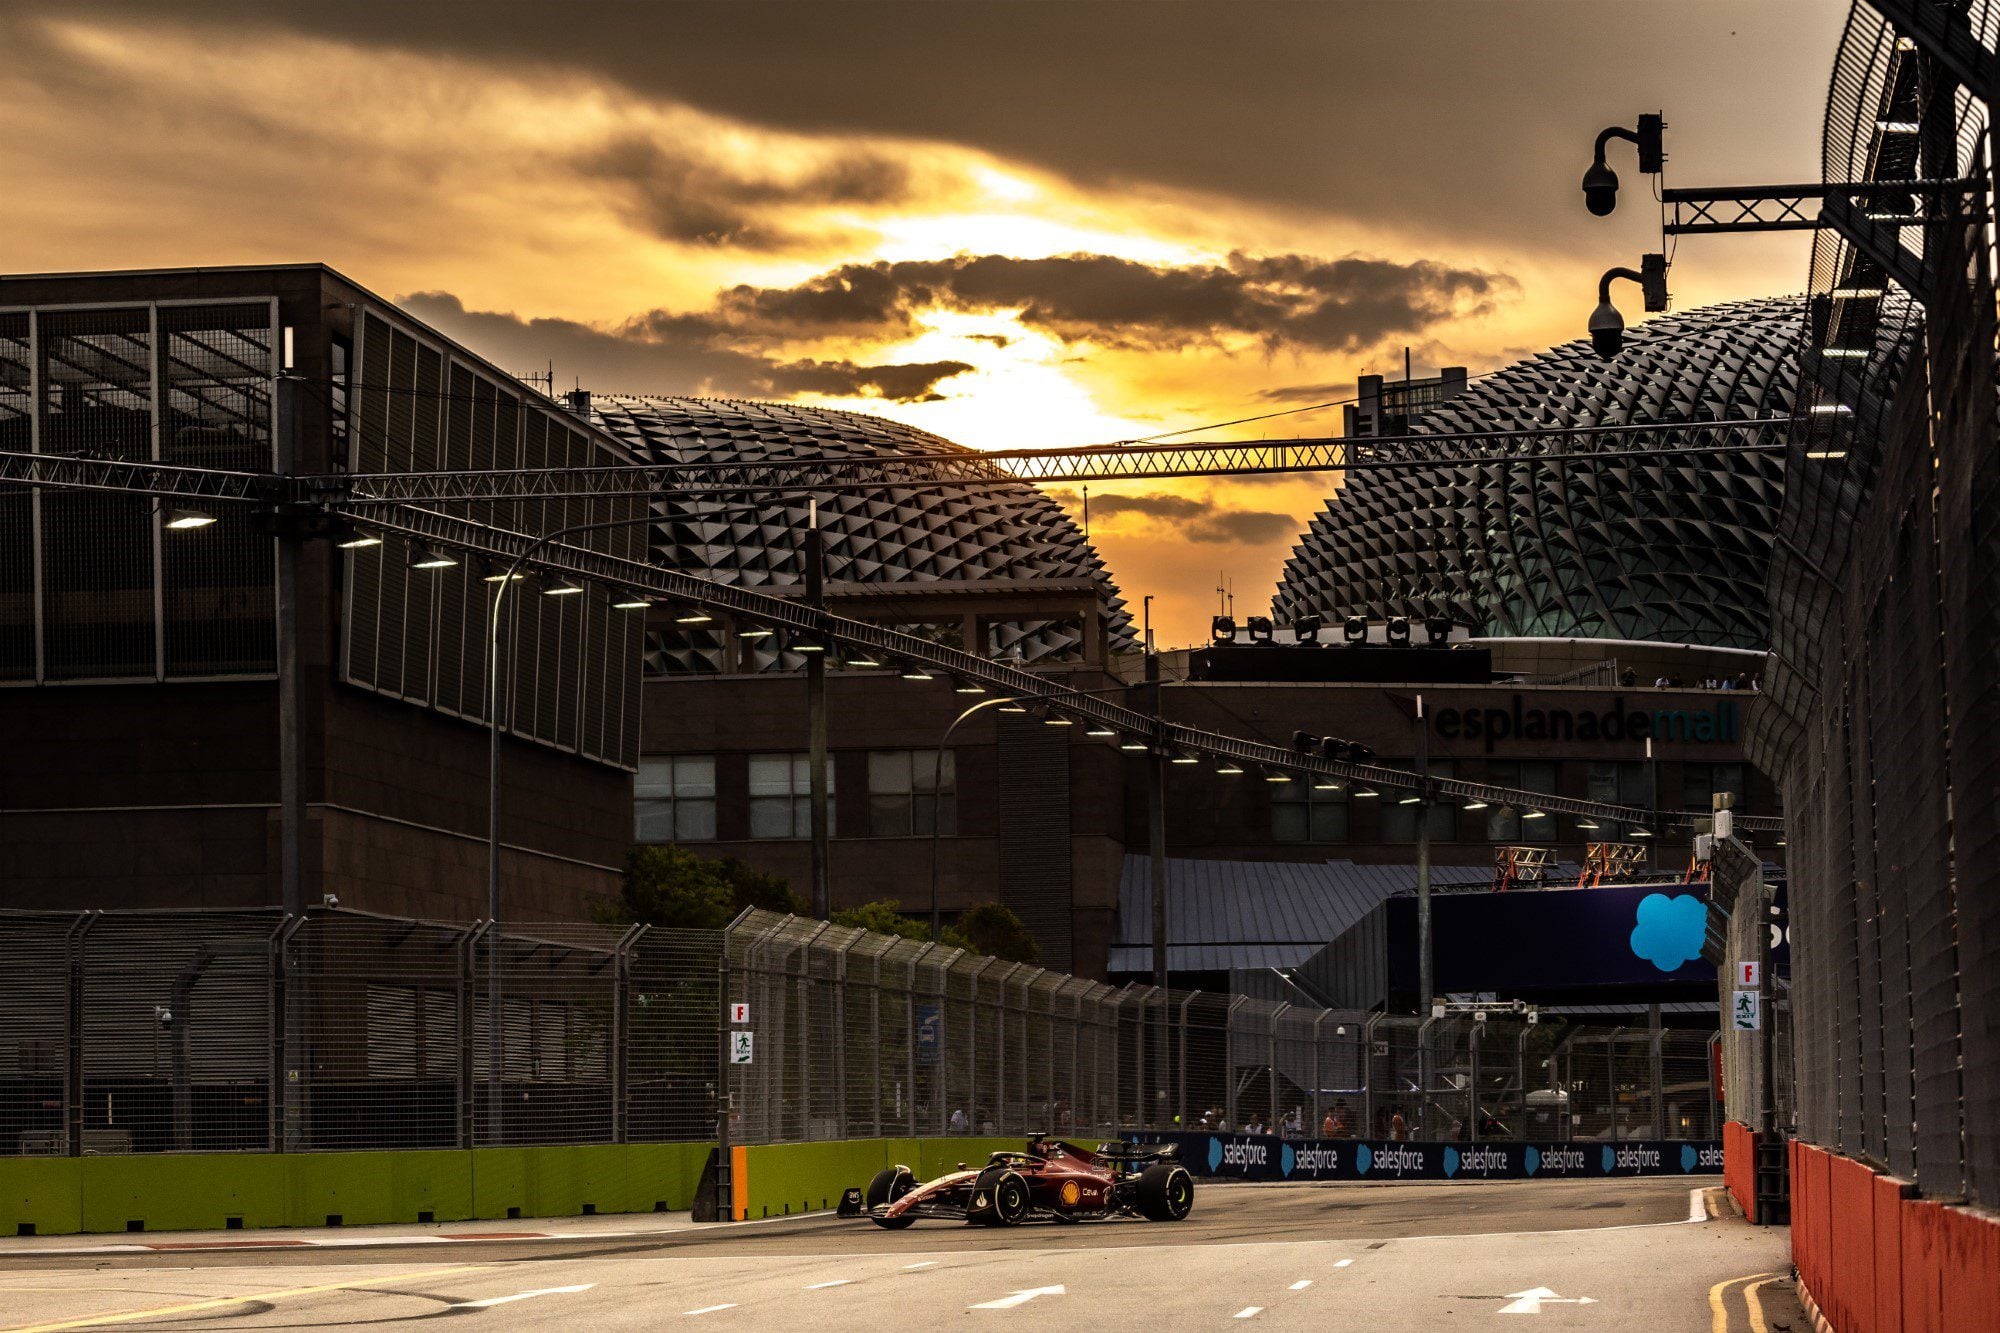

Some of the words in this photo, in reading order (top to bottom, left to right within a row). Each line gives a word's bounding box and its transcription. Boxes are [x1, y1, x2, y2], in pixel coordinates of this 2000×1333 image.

[1745, 965, 1752, 982] F
[737, 1006, 744, 1020] F
[1224, 1138, 1267, 1172] salesforce
[1296, 1143, 1337, 1177] salesforce
[1374, 1145, 1424, 1176] salesforce
[1461, 1146, 1507, 1176] salesforce
[1541, 1145, 1584, 1173] salesforce
[1616, 1144, 1660, 1174] salesforce
[1700, 1145, 1724, 1166] sales
